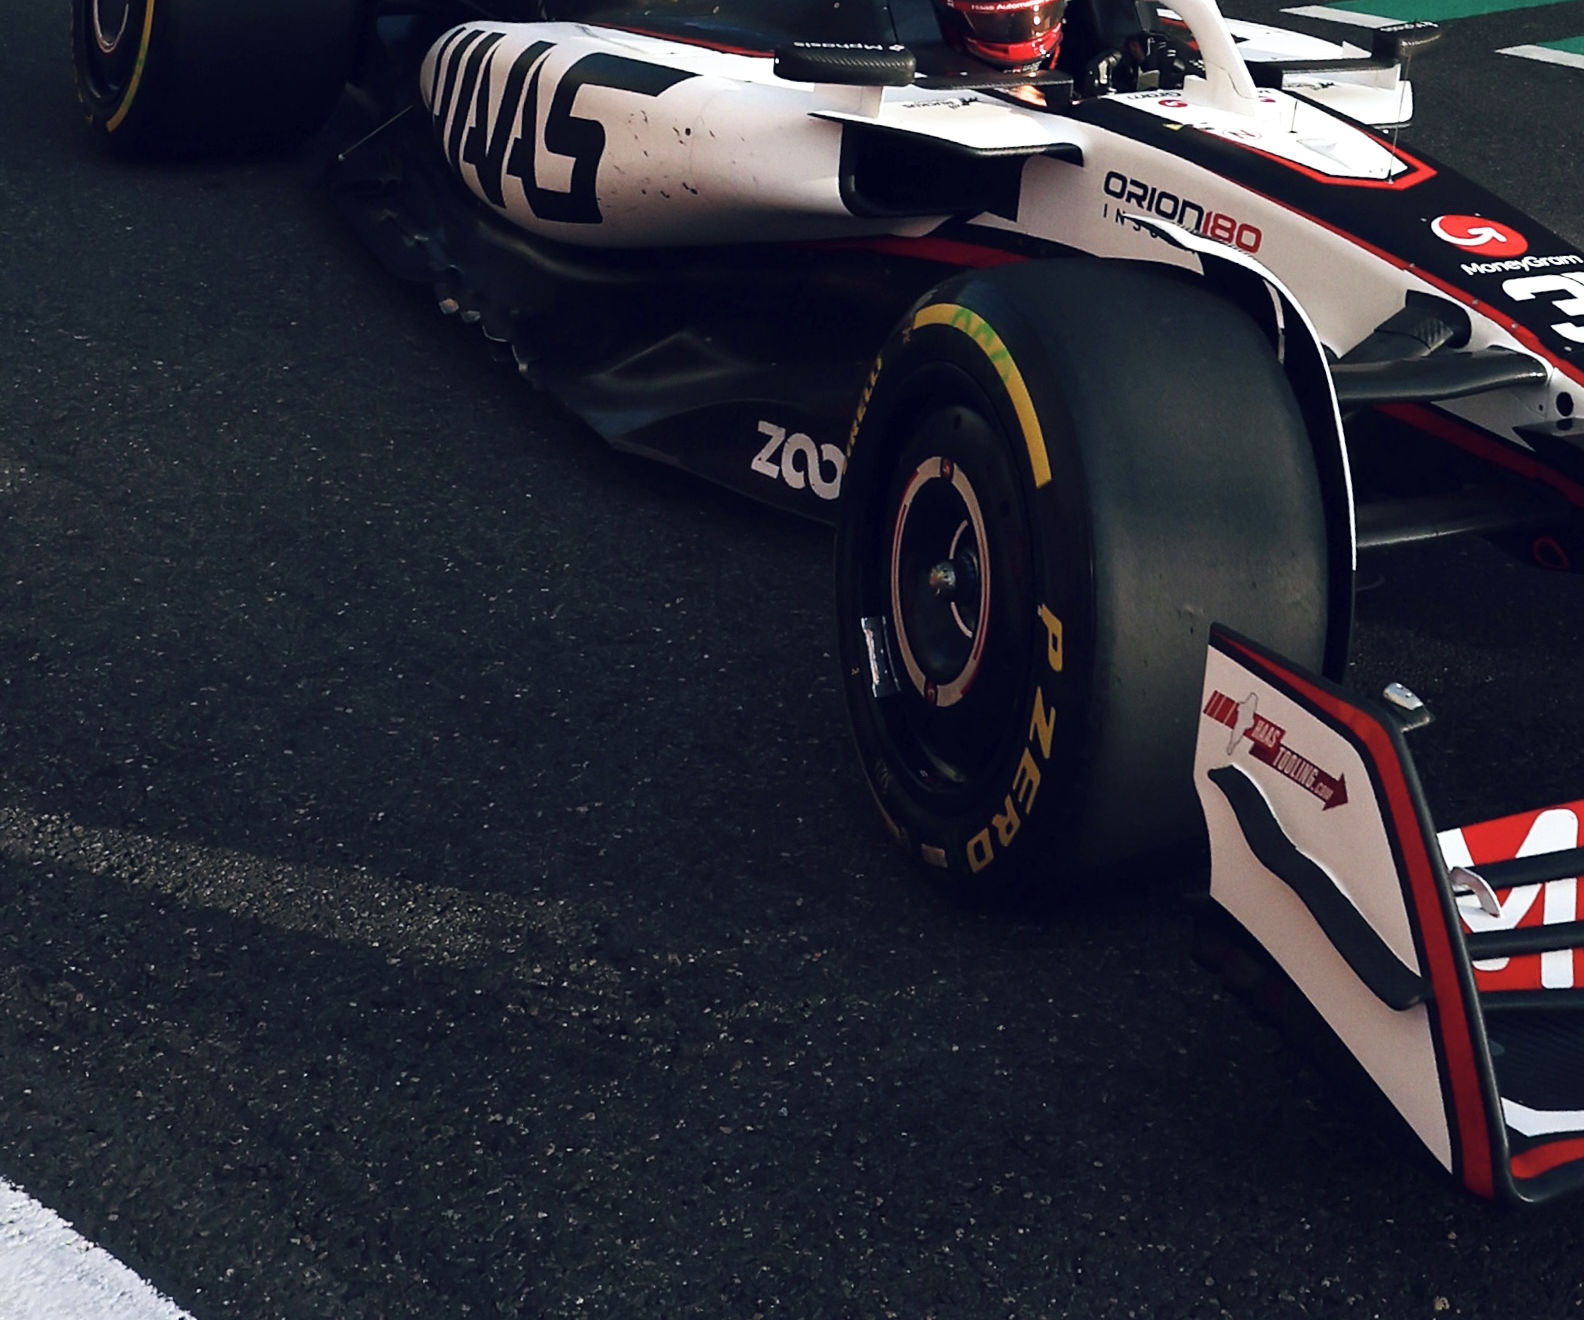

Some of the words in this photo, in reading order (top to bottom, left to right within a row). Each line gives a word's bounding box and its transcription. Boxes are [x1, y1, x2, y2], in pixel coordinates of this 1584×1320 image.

[431, 27, 704, 224] HAAS
[1103, 170, 1263, 254] ORION180
[1460, 253, 1584, 276] MoneyGram
[1038, 603, 1063, 672] P
[1251, 719, 1281, 748] HAAS
[966, 686, 1056, 874] ZERO
